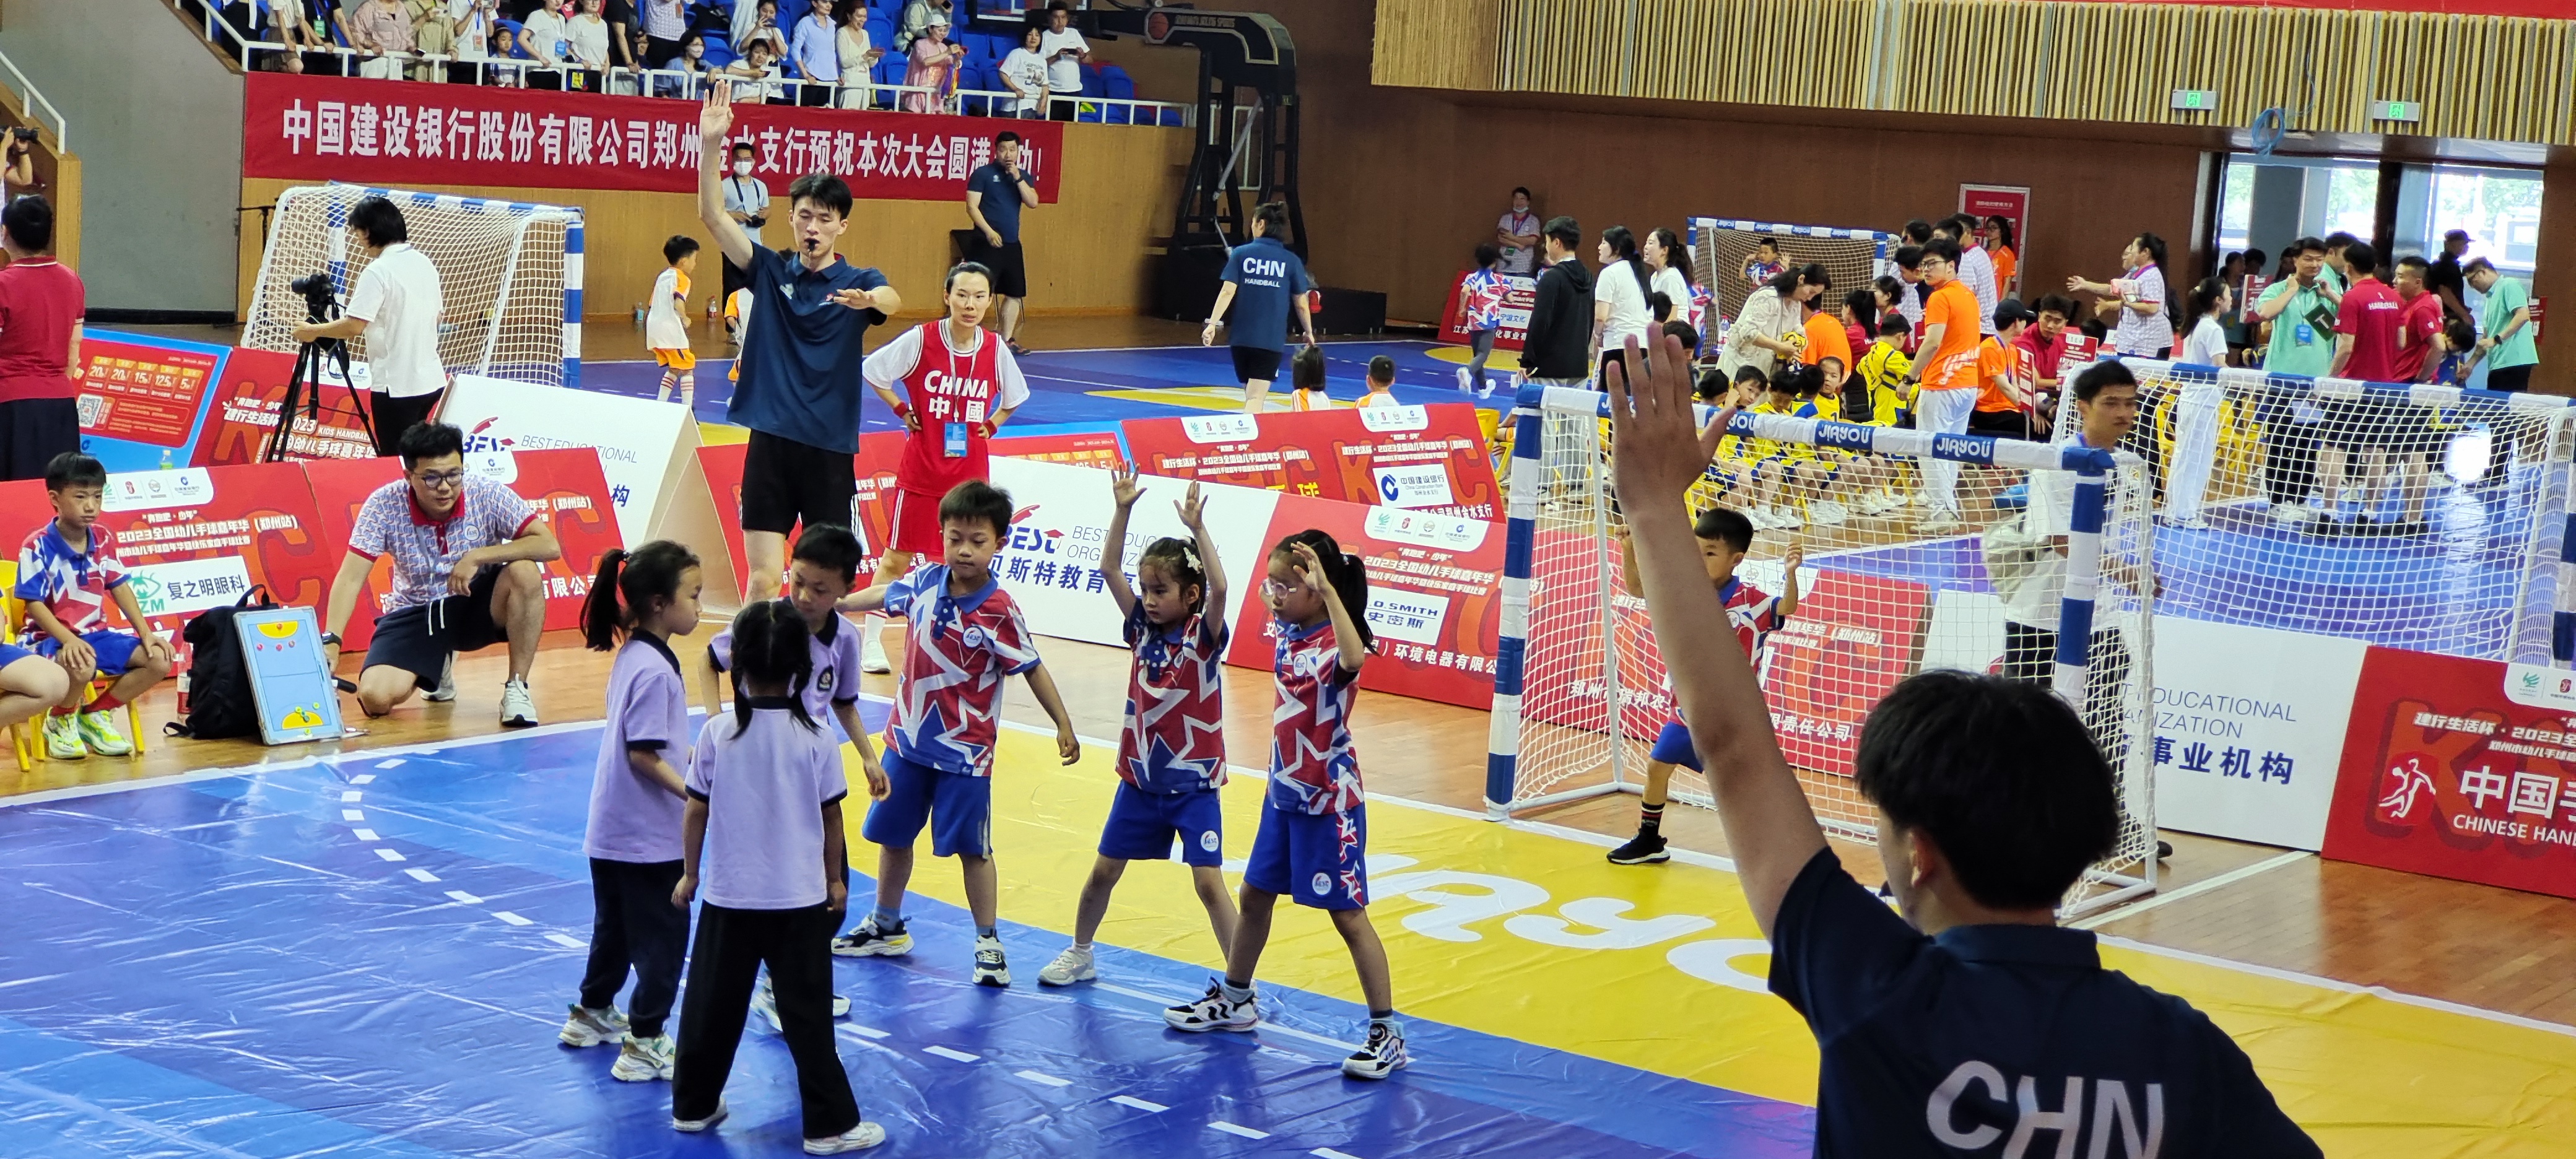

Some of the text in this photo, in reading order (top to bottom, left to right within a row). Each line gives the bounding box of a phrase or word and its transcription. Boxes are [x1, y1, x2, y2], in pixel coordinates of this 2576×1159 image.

[283, 98, 1042, 181] 中国建设银行股份有限公司郑州支行预祝本次大会圆满功!
[1243, 257, 1286, 278] CHN
[1244, 278, 1281, 288] HANDBALL
[925, 370, 988, 399] CHINA
[167, 575, 245, 601] 复之明眼科
[1367, 611, 1425, 630] 史密斯
[2453, 814, 2528, 839] CHINESE
[1926, 1061, 2164, 1159] CHN
